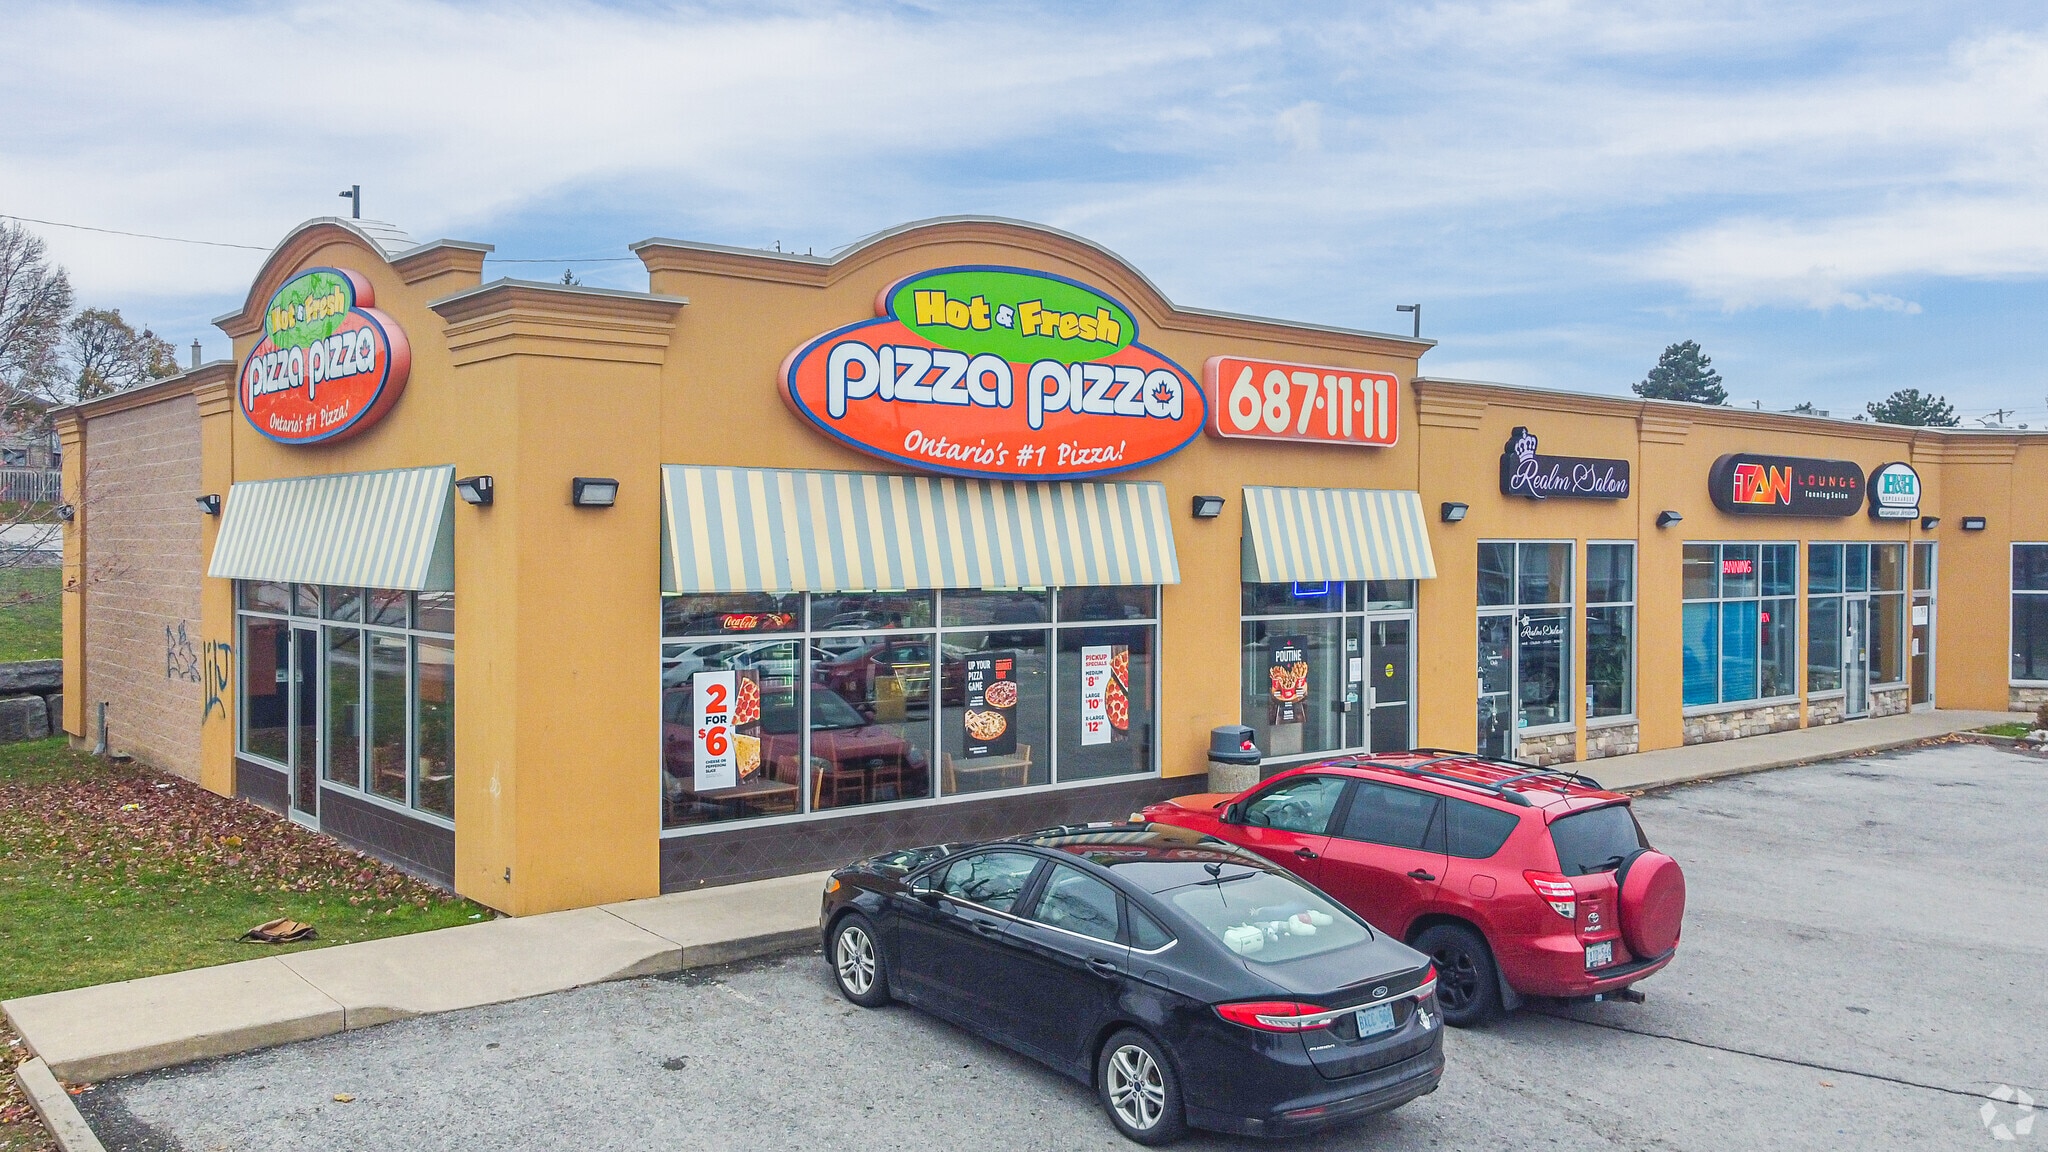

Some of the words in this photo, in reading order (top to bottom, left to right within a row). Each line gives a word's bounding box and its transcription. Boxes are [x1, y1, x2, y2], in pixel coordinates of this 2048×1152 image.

[271, 302, 296, 335] Hot
[304, 284, 345, 325] Fresh
[913, 289, 991, 331] Hot
[995, 304, 1015, 329] &
[1017, 299, 1121, 347] Fresh
[826, 340, 1013, 419] pizza
[269, 412, 303, 433] Ontario's
[305, 413, 317, 431] #1
[320, 399, 349, 427] Pizza!
[903, 429, 1010, 467] Ontario's
[1016, 444, 1046, 466] #1
[1057, 440, 1126, 468] Pizza!
[1510, 459, 1570, 499] Realm
[1572, 463, 1628, 493] Salon
[1733, 463, 1793, 506] iTAN
[1798, 474, 1857, 489] LOUNGE
[1883, 473, 1915, 495] H&H
[1805, 490, 1830, 500] Tanning
[1831, 491, 1849, 499] Salon
[967, 661, 976, 670] UP
[976, 659, 991, 669] YOUR
[1275, 649, 1302, 662] POUTINE
[968, 671, 983, 681] PIZZA
[968, 681, 983, 692] GAME
[706, 683, 727, 714] 2
[705, 715, 727, 725] FOR
[698, 726, 728, 756] $6
